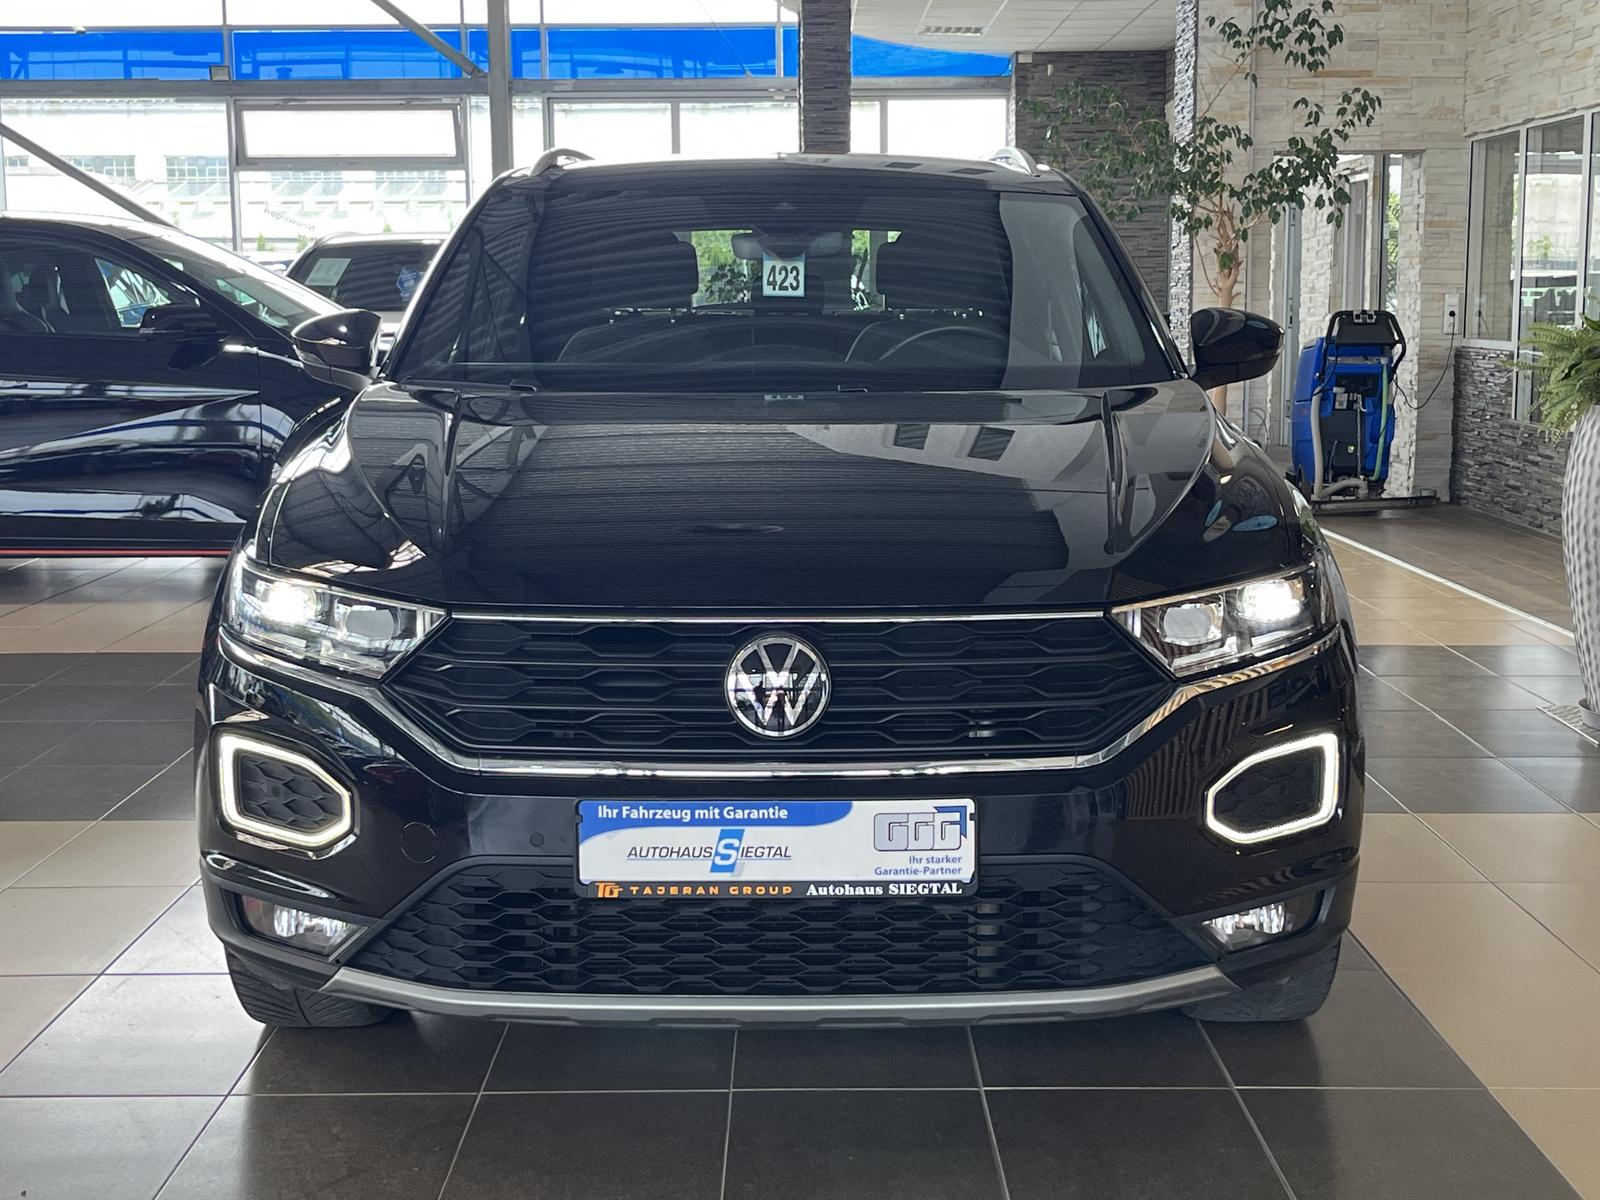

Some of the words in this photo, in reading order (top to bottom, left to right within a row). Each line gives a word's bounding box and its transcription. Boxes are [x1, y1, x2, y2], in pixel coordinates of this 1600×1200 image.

[767, 265, 800, 291] 423
[598, 805, 618, 819] Ihr
[622, 805, 691, 822] Fahrzeug
[695, 805, 720, 819] mit
[723, 805, 788, 820] Garantie
[627, 846, 713, 858] AUTOHAUS
[909, 855, 923, 865] Ihr
[926, 855, 962, 864] starker
[874, 866, 962, 876] Garantie-Partner
[630, 886, 719, 895] TAJERAN
[729, 886, 793, 895] GROUP
[806, 883, 883, 896] Autohaus
[888, 882, 962, 895] SIEGTAL
